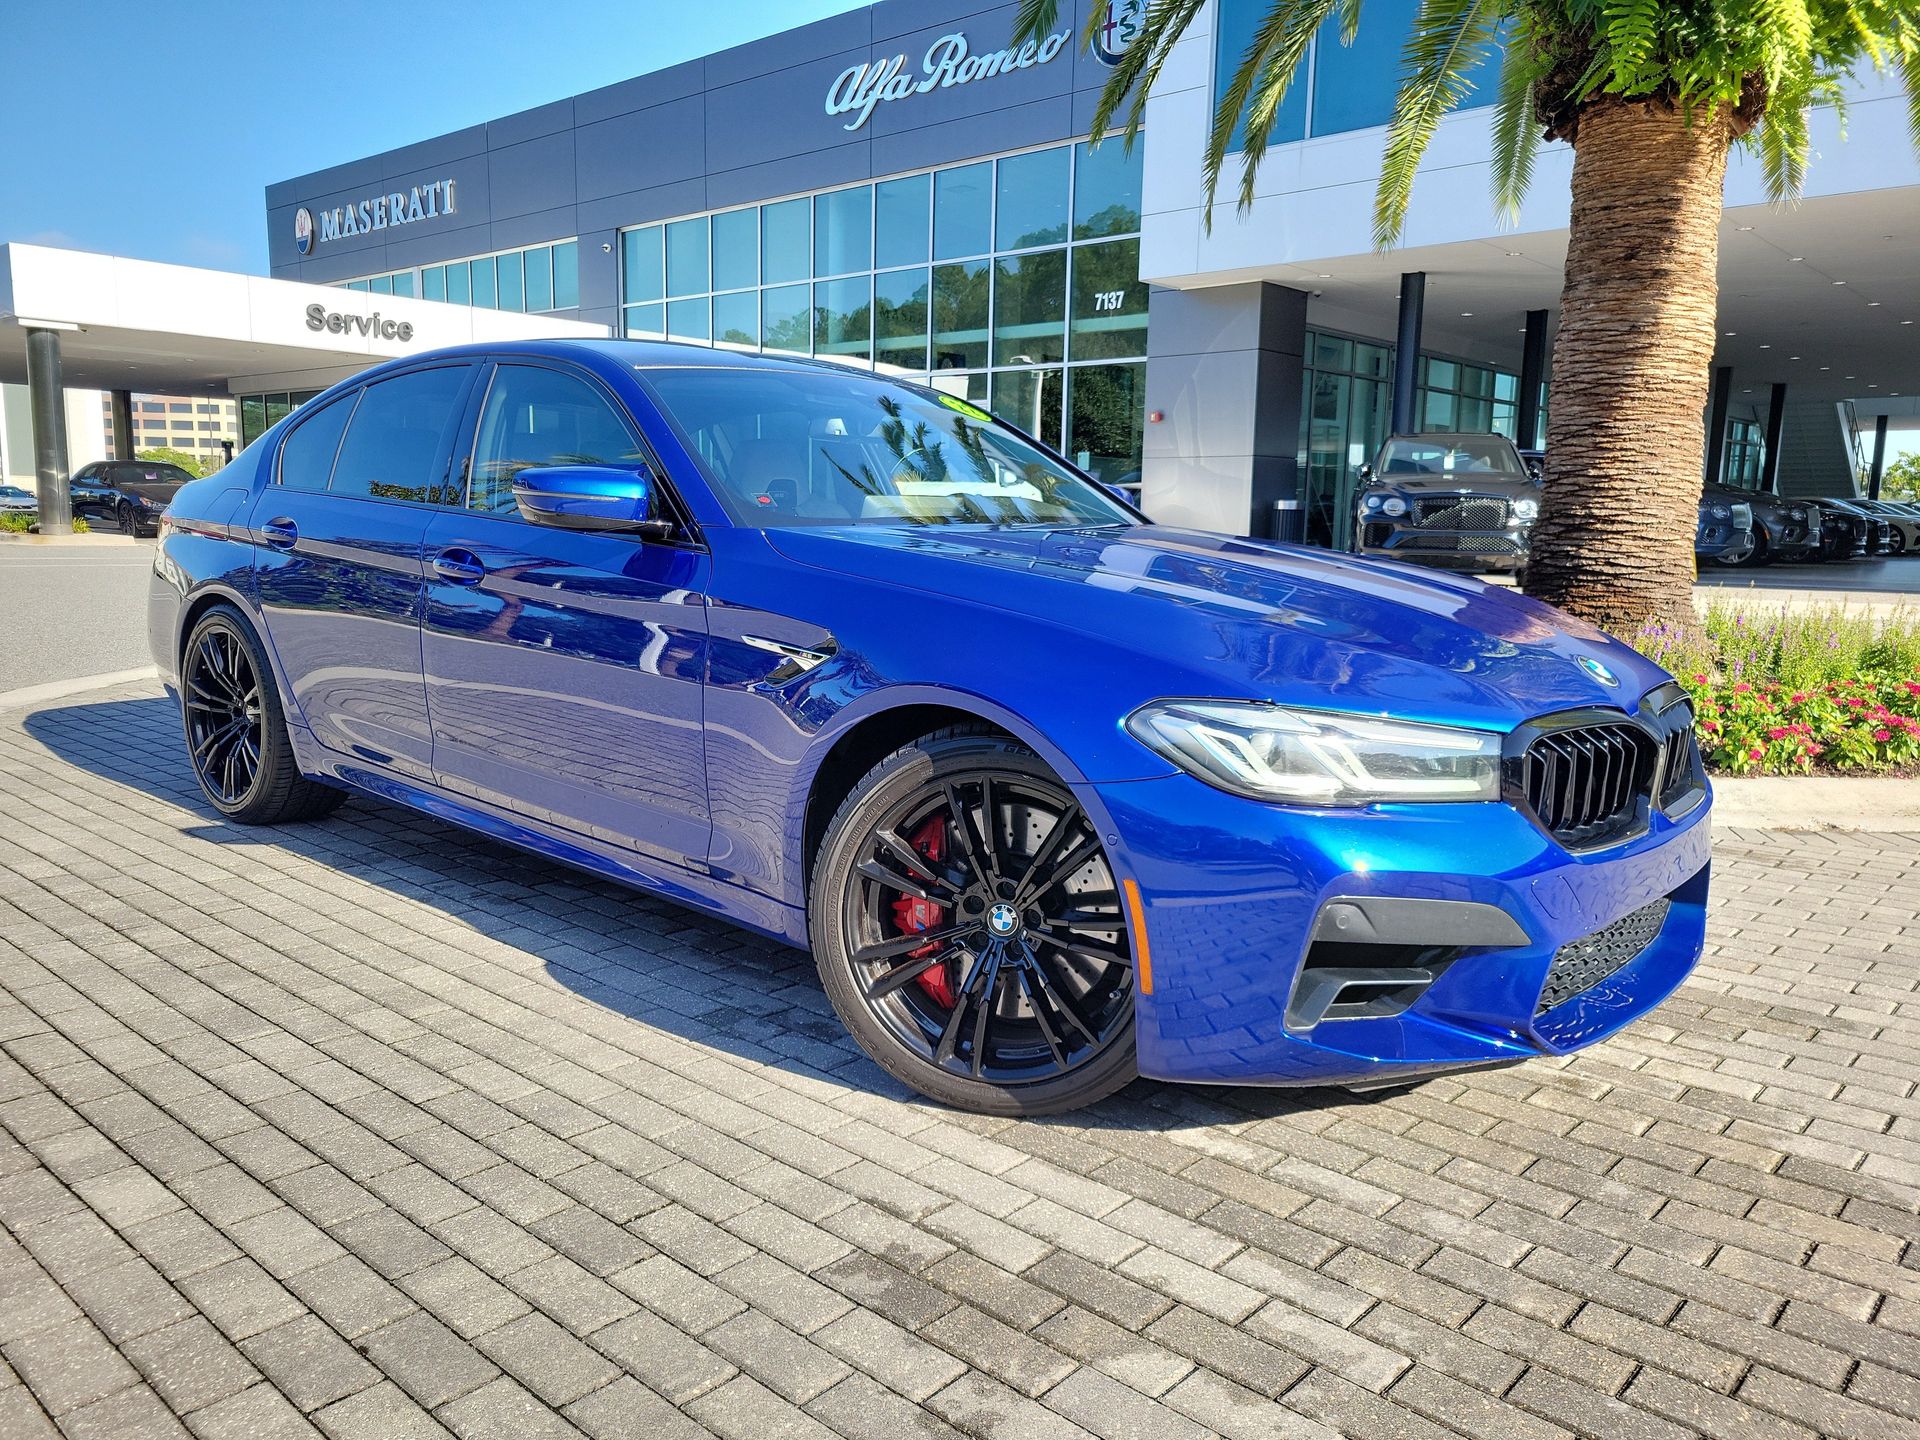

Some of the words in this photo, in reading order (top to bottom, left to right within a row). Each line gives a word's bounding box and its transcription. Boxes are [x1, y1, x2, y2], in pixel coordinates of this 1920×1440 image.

[824, 54, 918, 131] Alfa
[916, 29, 1072, 93] Romeo
[319, 178, 456, 243] MASERATI
[305, 303, 413, 342] Service
[1094, 290, 1125, 311] 7137
